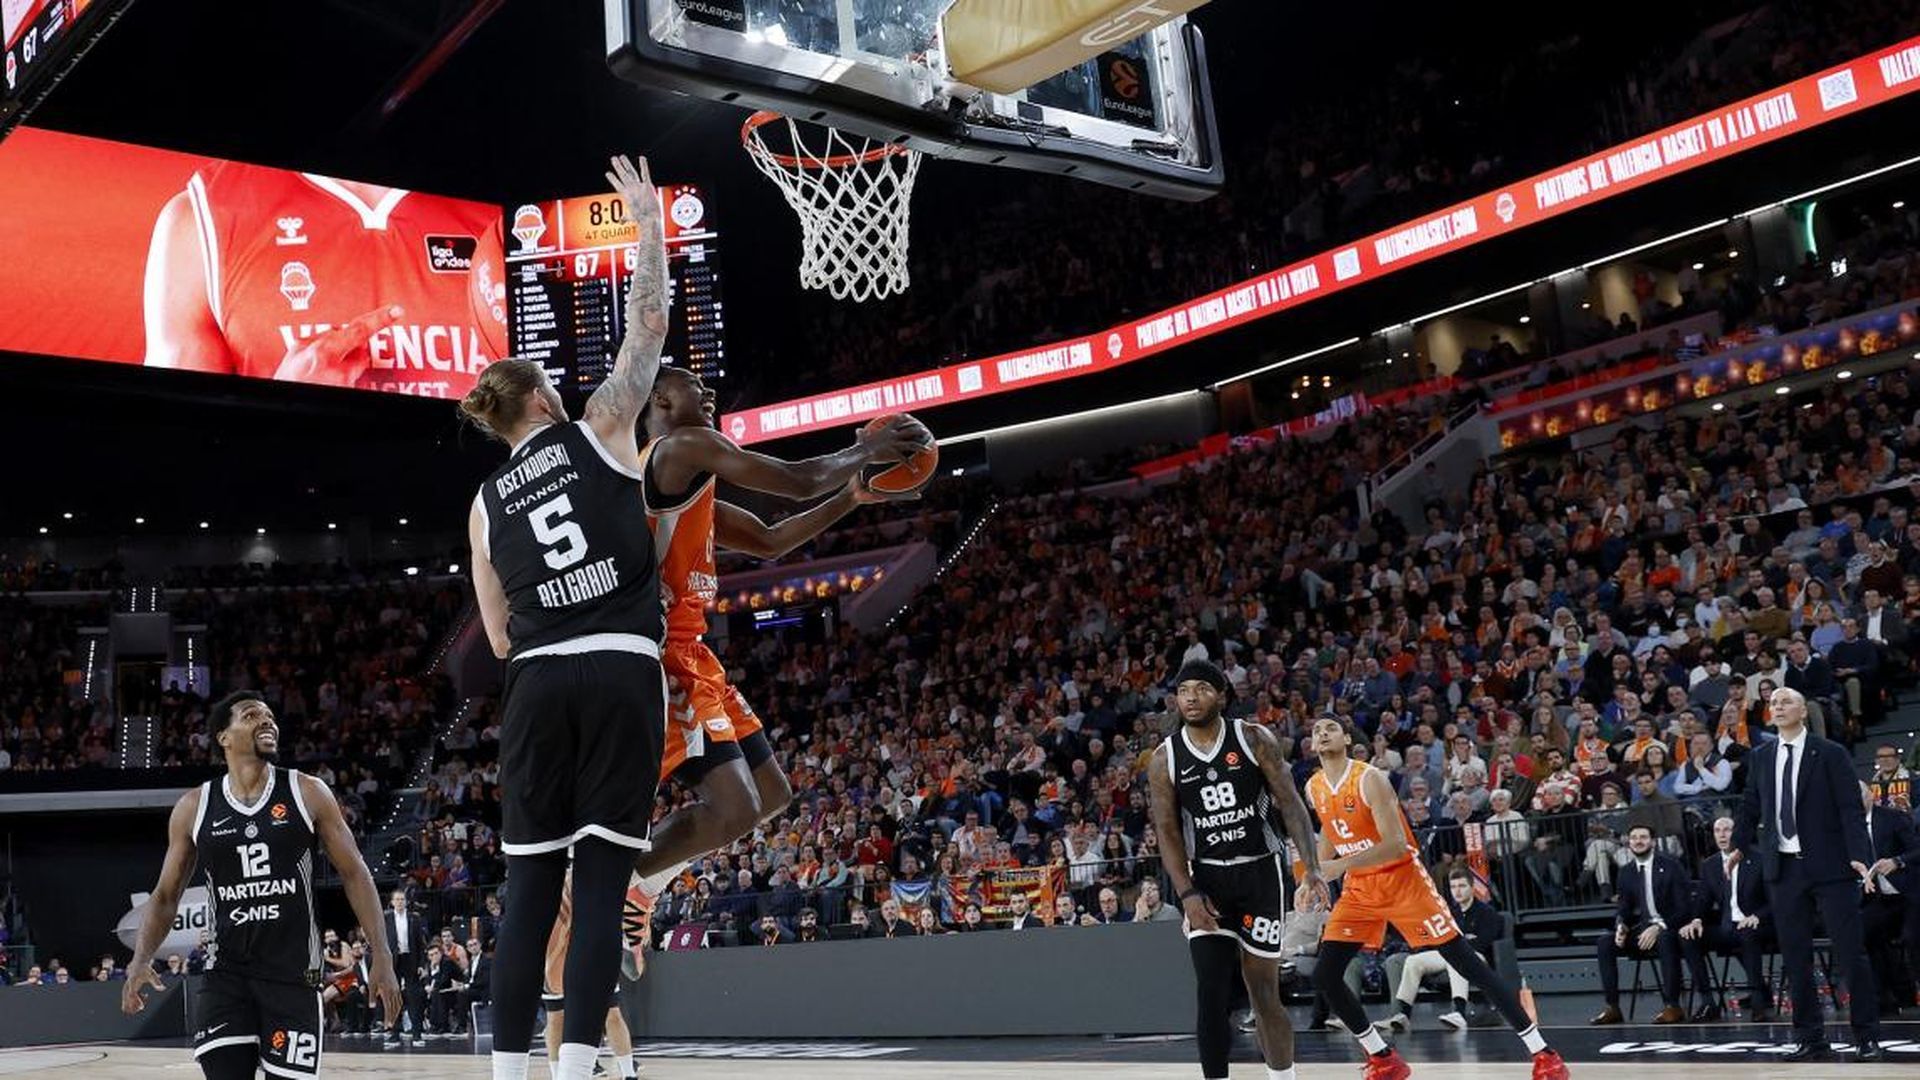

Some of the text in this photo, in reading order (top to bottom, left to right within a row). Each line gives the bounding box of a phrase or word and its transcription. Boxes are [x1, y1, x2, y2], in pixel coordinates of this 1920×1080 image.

[23, 26, 37, 63] 67
[1534, 166, 1589, 210] PARTIDOS
[1607, 140, 1664, 184] VALENCIA
[1660, 123, 1708, 166] BASKET
[1725, 113, 1741, 142] A
[1735, 107, 1757, 139] LA
[1754, 91, 1799, 132] VENTA
[575, 253, 599, 278] 67
[496, 443, 572, 500] OSETKOWSKI
[505, 471, 580, 515] CHANGAN
[528, 493, 589, 571] 5
[536, 557, 619, 608] BELGRADE
[1200, 782, 1236, 812] 88
[1194, 805, 1255, 829] PARTIZAN
[1331, 819, 1354, 838] 12
[236, 842, 271, 878] 12
[218, 878, 296, 901] PARTIZAN
[1251, 916, 1280, 944] 88
[1423, 913, 1451, 938] 12
[287, 1030, 317, 1068] 12
